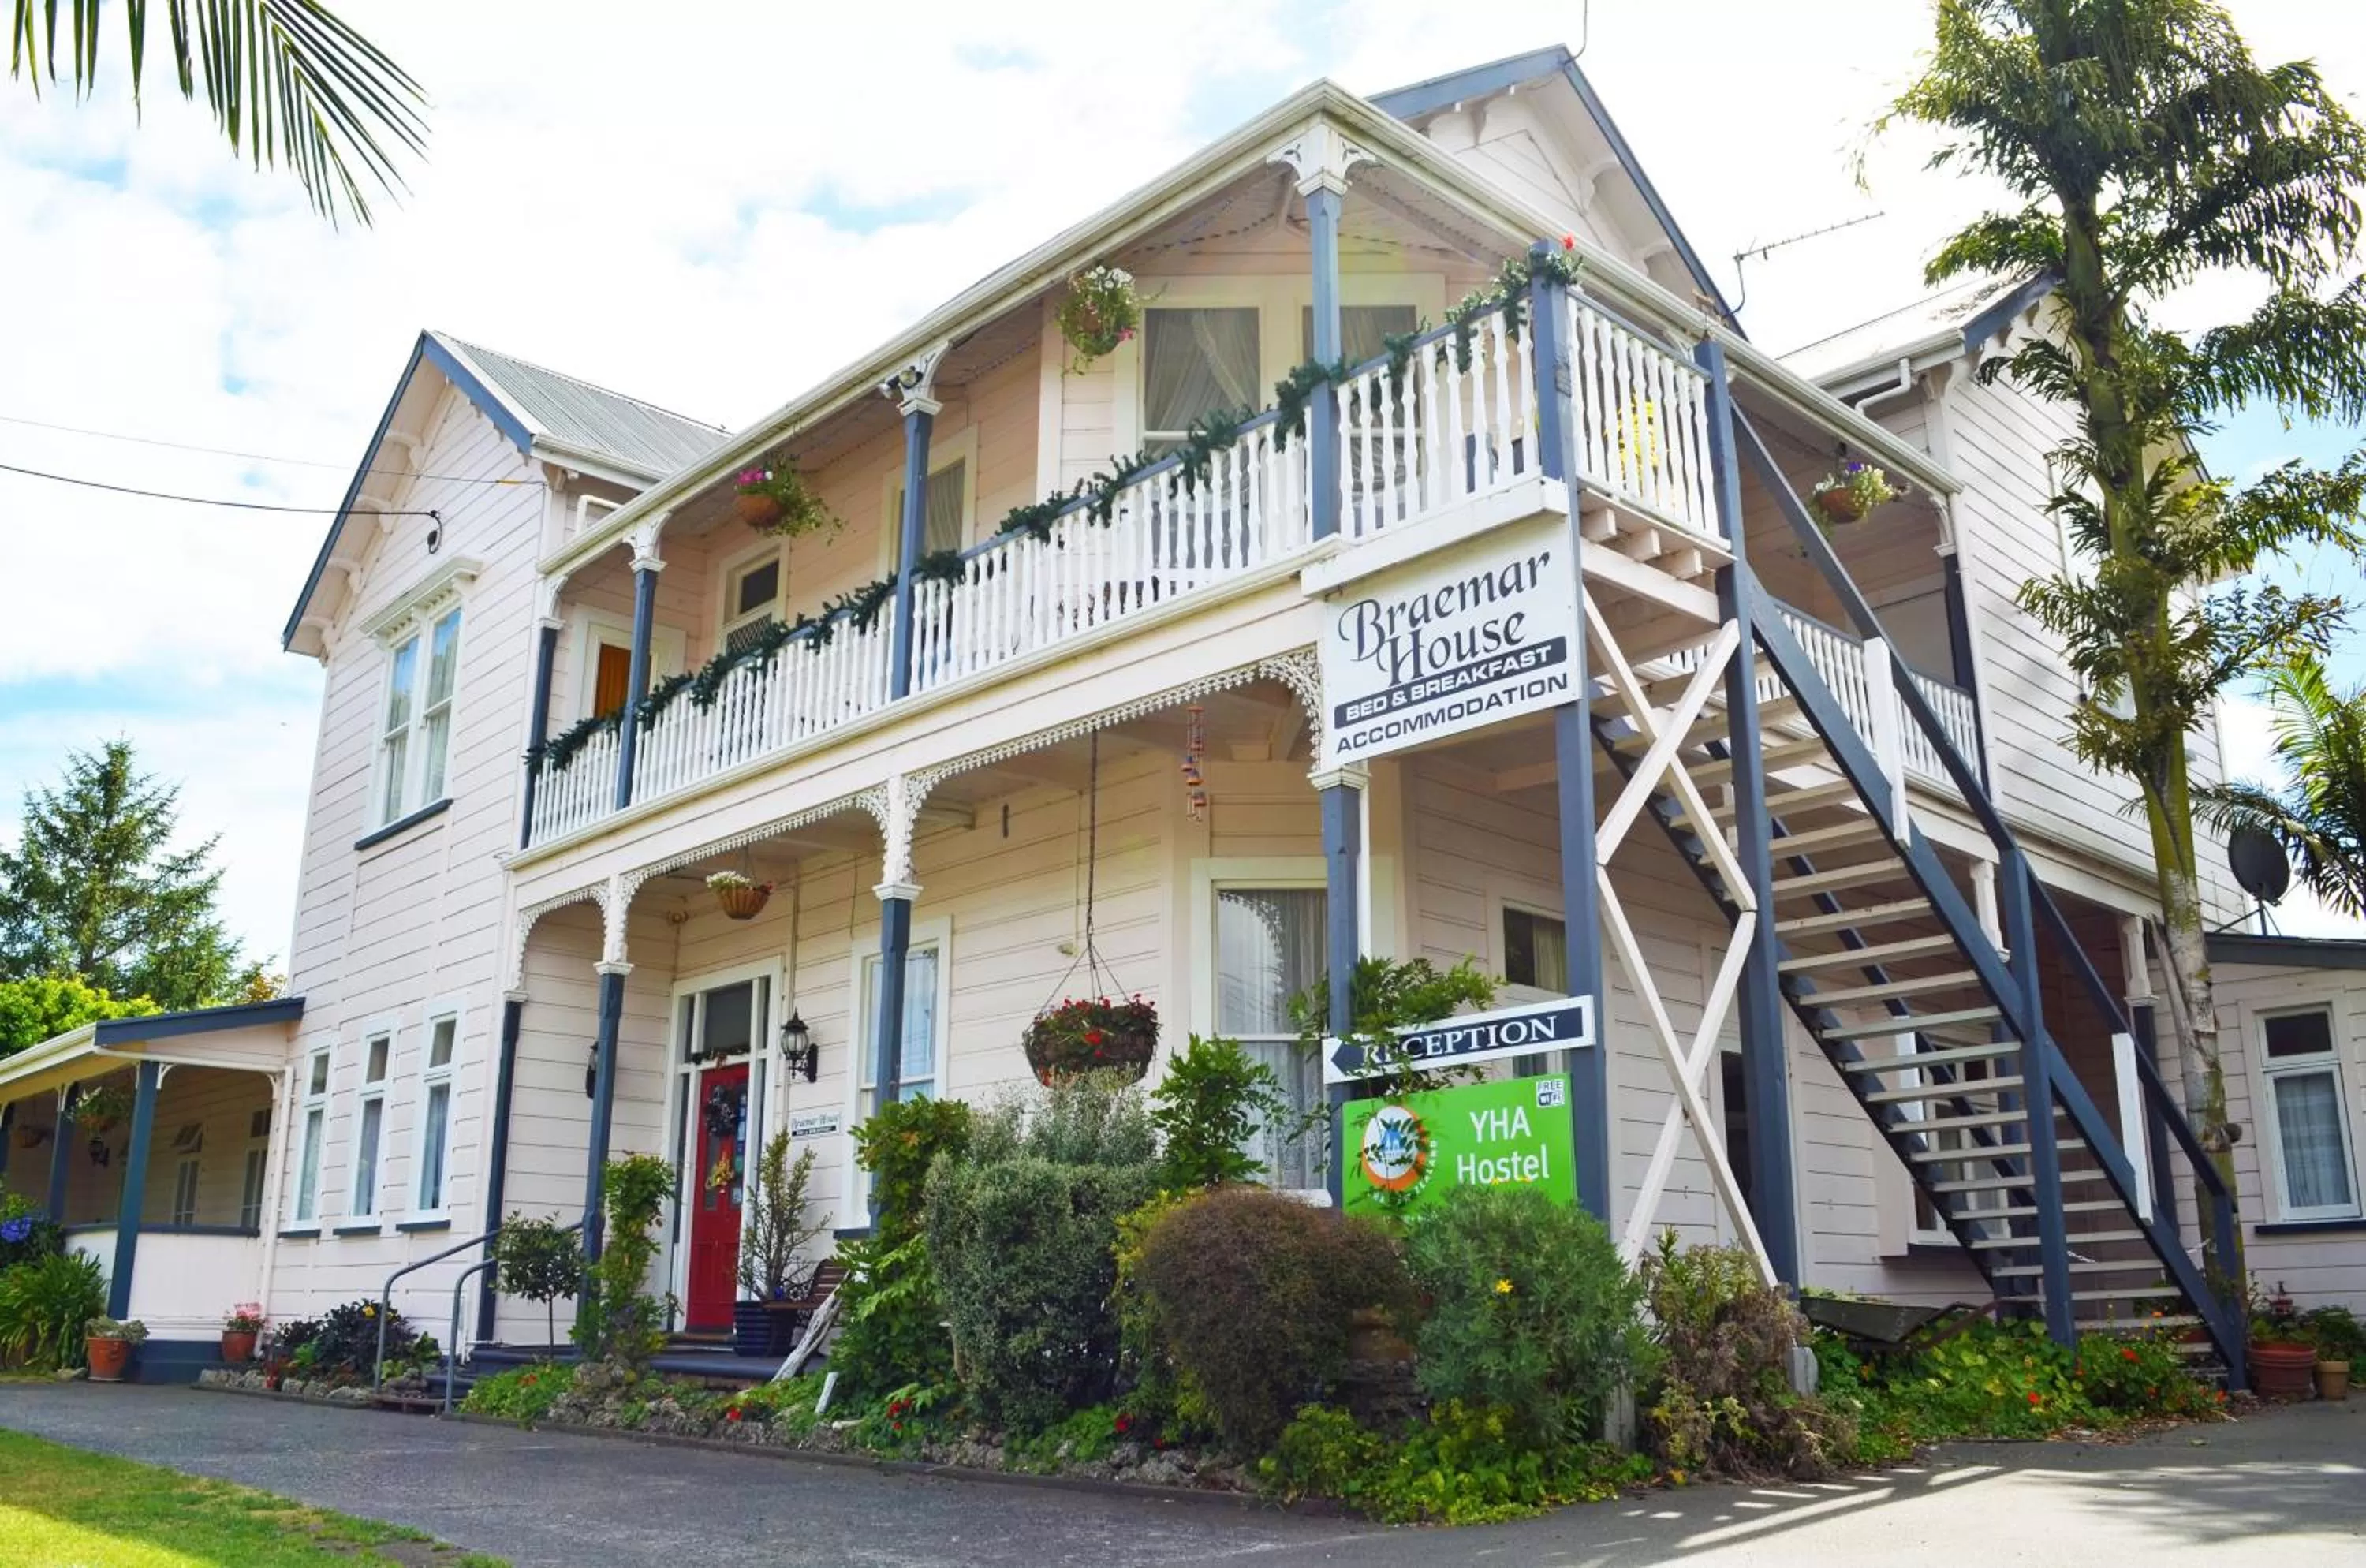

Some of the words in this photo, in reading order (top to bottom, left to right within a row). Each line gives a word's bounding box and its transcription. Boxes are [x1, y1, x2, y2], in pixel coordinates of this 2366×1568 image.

[1338, 552, 1550, 661] Braemar
[1346, 696, 1387, 721] BED
[1392, 691, 1407, 707] &
[1411, 645, 1551, 700] BREAKFAST
[1376, 612, 1525, 686] House
[1337, 672, 1568, 754] ACCOMMODATION
[1469, 1106, 1532, 1143] YHA
[1457, 1143, 1550, 1185] Hostel
